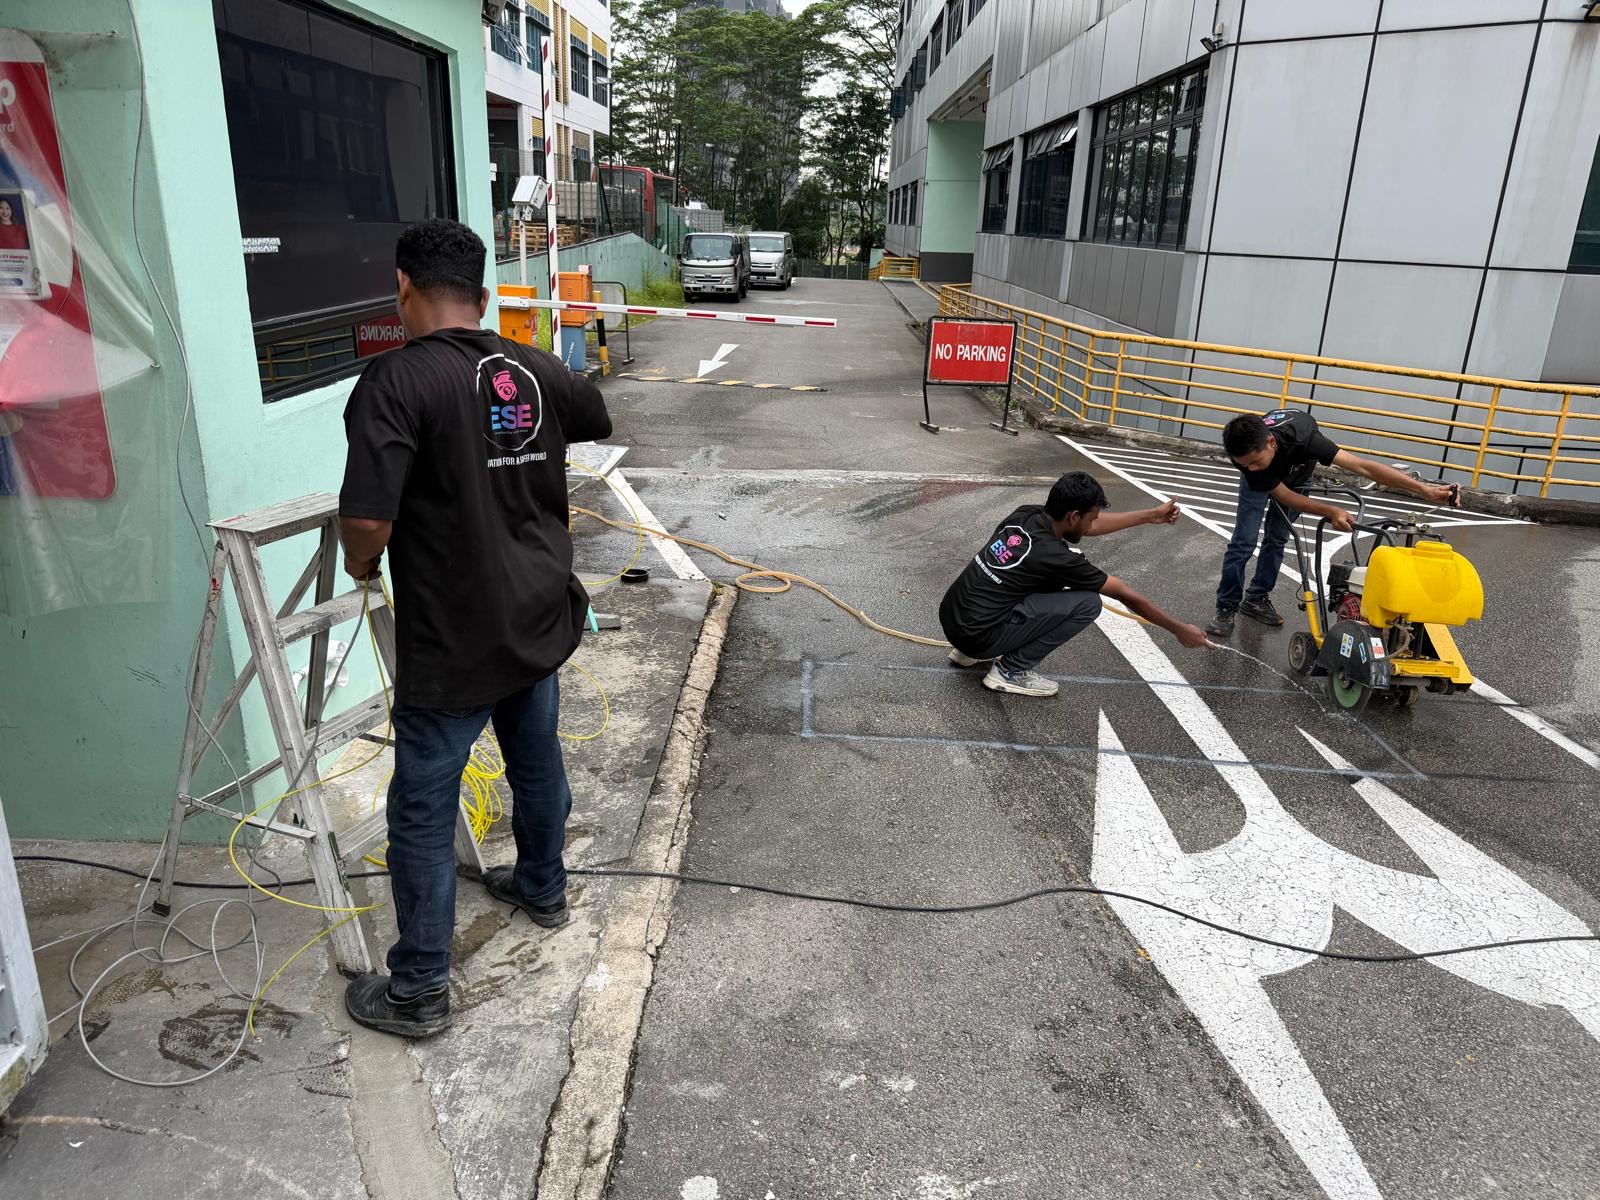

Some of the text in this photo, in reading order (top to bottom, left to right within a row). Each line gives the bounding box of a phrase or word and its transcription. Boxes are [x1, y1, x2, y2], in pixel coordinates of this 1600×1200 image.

[935, 344, 1006, 362] NO PARKING
[490, 404, 533, 430] ESE
[502, 457, 515, 466] FOR
[990, 539, 1013, 564] ESE
